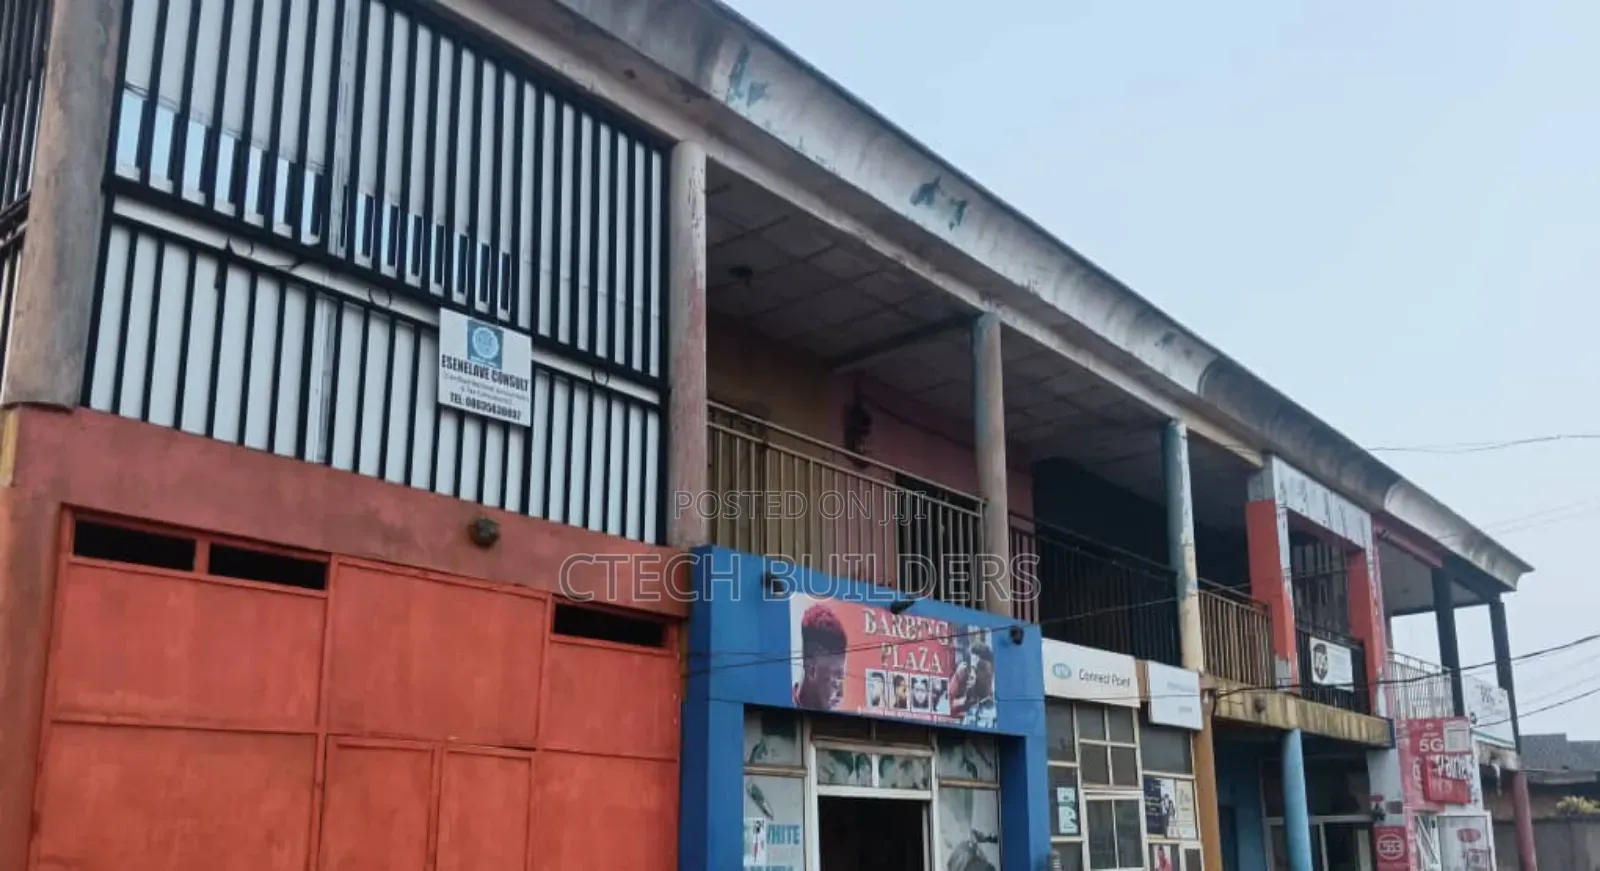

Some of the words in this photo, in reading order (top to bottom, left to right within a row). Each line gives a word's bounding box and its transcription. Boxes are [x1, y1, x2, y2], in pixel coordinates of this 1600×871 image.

[862, 607, 949, 646] BARBING
[881, 643, 944, 674] PLAZA
[1079, 668, 1111, 685] Connect
[1112, 674, 1131, 687] Point
[1419, 738, 1444, 752] 5G
